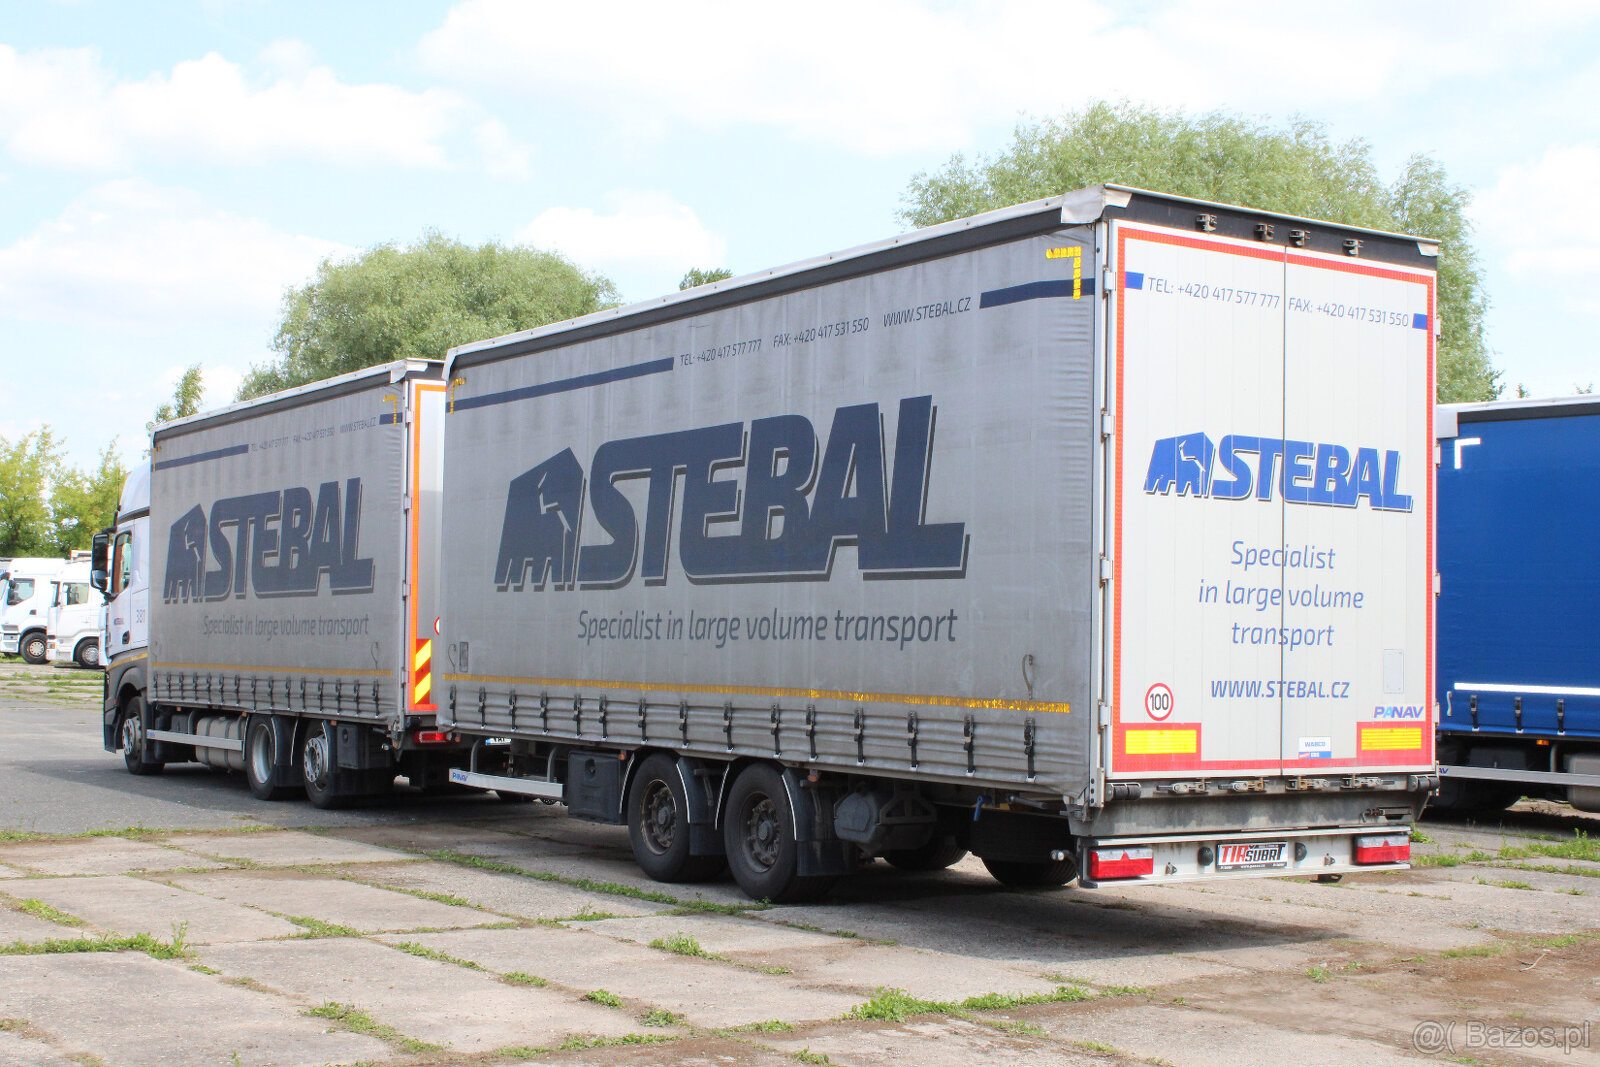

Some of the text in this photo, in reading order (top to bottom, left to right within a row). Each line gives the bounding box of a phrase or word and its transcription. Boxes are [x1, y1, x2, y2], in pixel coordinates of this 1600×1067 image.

[1148, 277, 1280, 309] TEL: +420 417 577 777
[1288, 297, 1409, 327] FAX: +420 417 531 550
[680, 296, 972, 367] TEL: +420 417 577 777 FAX: +420 417 531 550 WWW.STEBAL.CZ
[1211, 434, 1414, 513] STEBAL
[574, 394, 971, 589] STEBAL
[205, 476, 376, 602] STEBAL
[1230, 540, 1336, 571] Specialist
[1198, 579, 1365, 612] in large volume
[202, 613, 370, 641] Specialist in large volume transport
[577, 607, 959, 651] Specialist in large volume transport
[1231, 622, 1335, 651] transport
[1149, 692, 1170, 712] 100
[1211, 679, 1351, 700] WWW.STEBAL.CZ
[1373, 705, 1424, 719] PANAV
